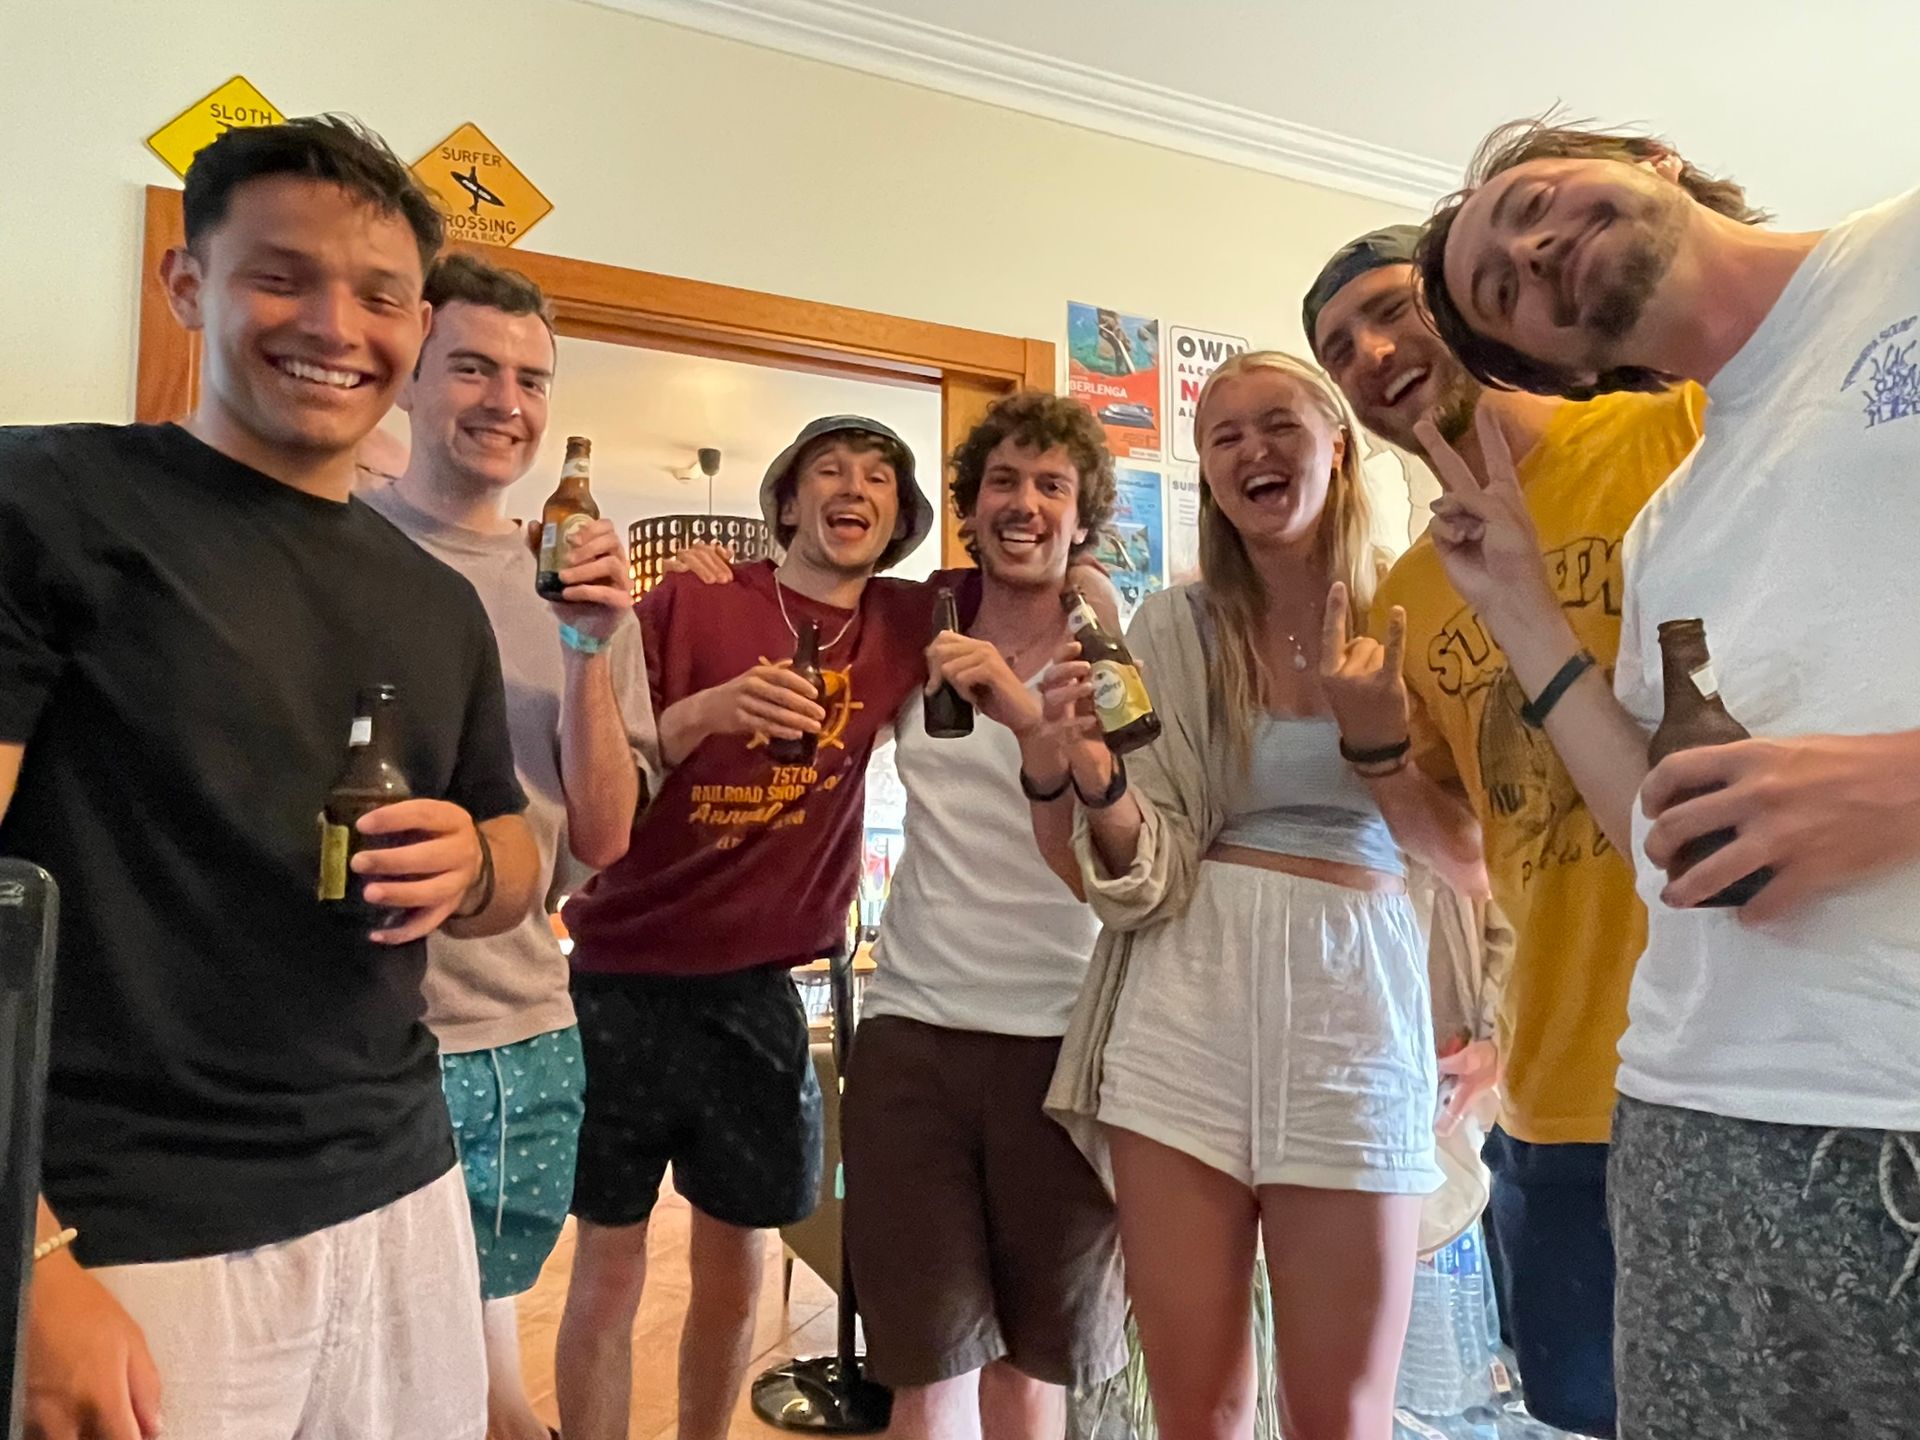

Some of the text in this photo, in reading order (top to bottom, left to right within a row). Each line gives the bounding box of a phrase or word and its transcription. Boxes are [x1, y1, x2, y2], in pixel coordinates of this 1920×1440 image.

[210, 103, 272, 125] SLOTH
[442, 146, 502, 167] SURFER
[446, 214, 516, 235] ROSSING
[450, 228, 478, 240] OSTA
[1178, 363, 1214, 377] ALCO
[1069, 379, 1128, 399] BERLENGA
[1181, 379, 1199, 402] N
[771, 766, 818, 785] 757th
[691, 784, 763, 803] RAILROAD
